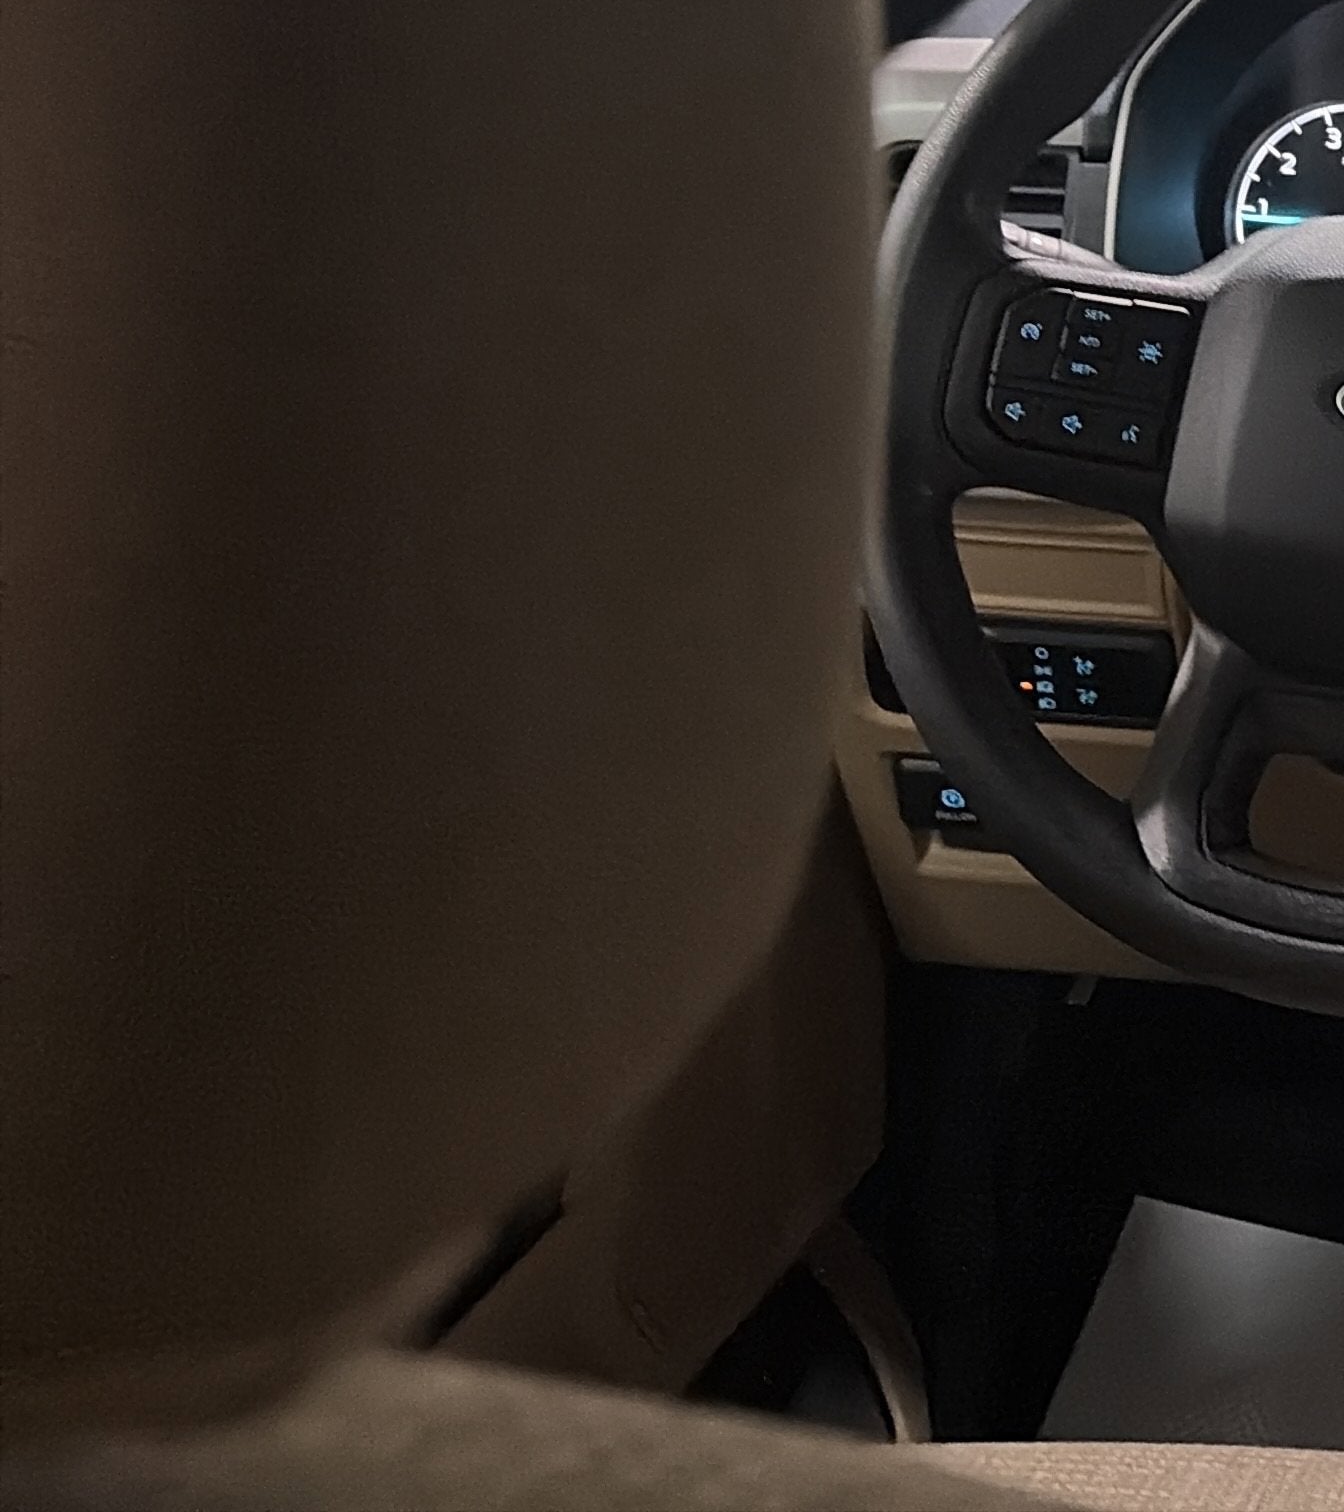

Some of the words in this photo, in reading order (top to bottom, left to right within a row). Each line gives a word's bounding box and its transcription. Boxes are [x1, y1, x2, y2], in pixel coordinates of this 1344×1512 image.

[1324, 127, 1342, 150] 3
[1279, 152, 1297, 176] 2
[1258, 197, 1269, 216] 1
